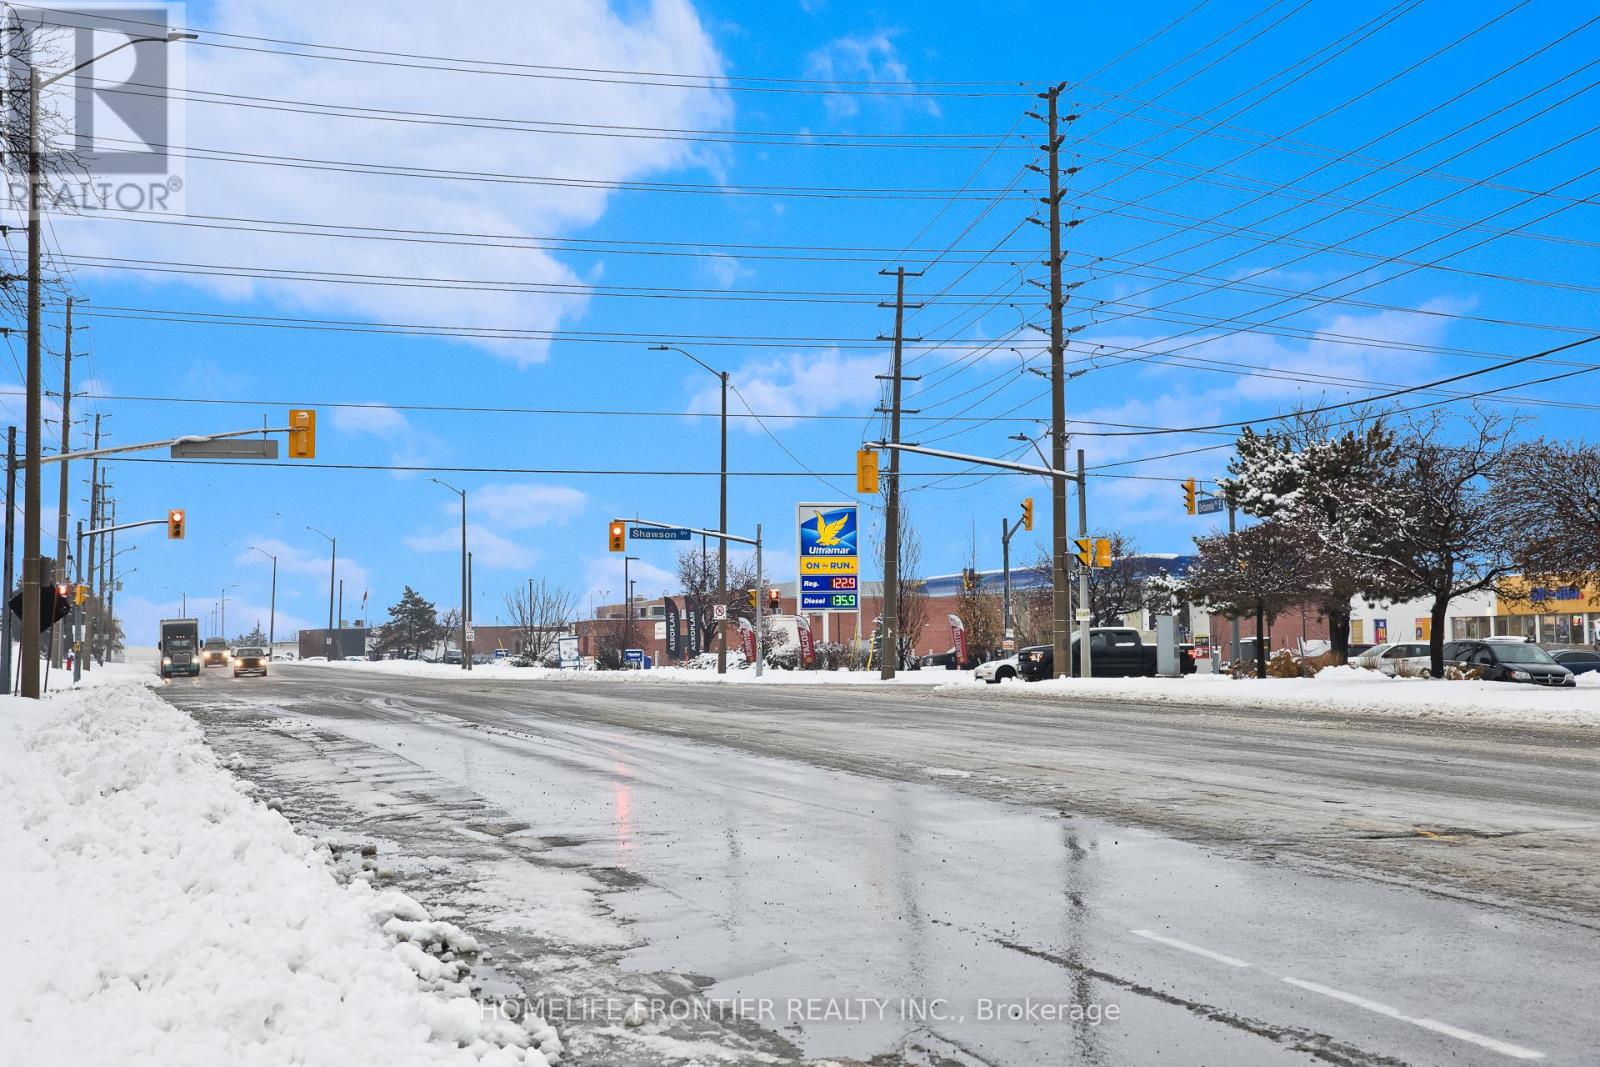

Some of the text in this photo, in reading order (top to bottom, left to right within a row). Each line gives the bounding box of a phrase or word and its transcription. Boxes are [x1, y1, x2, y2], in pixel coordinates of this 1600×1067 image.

[632, 530, 677, 539] Shawson
[809, 546, 850, 554] Ultramar
[803, 580, 820, 588] Reg.
[803, 597, 826, 605] Diesel
[801, 629, 811, 658] TACOS
